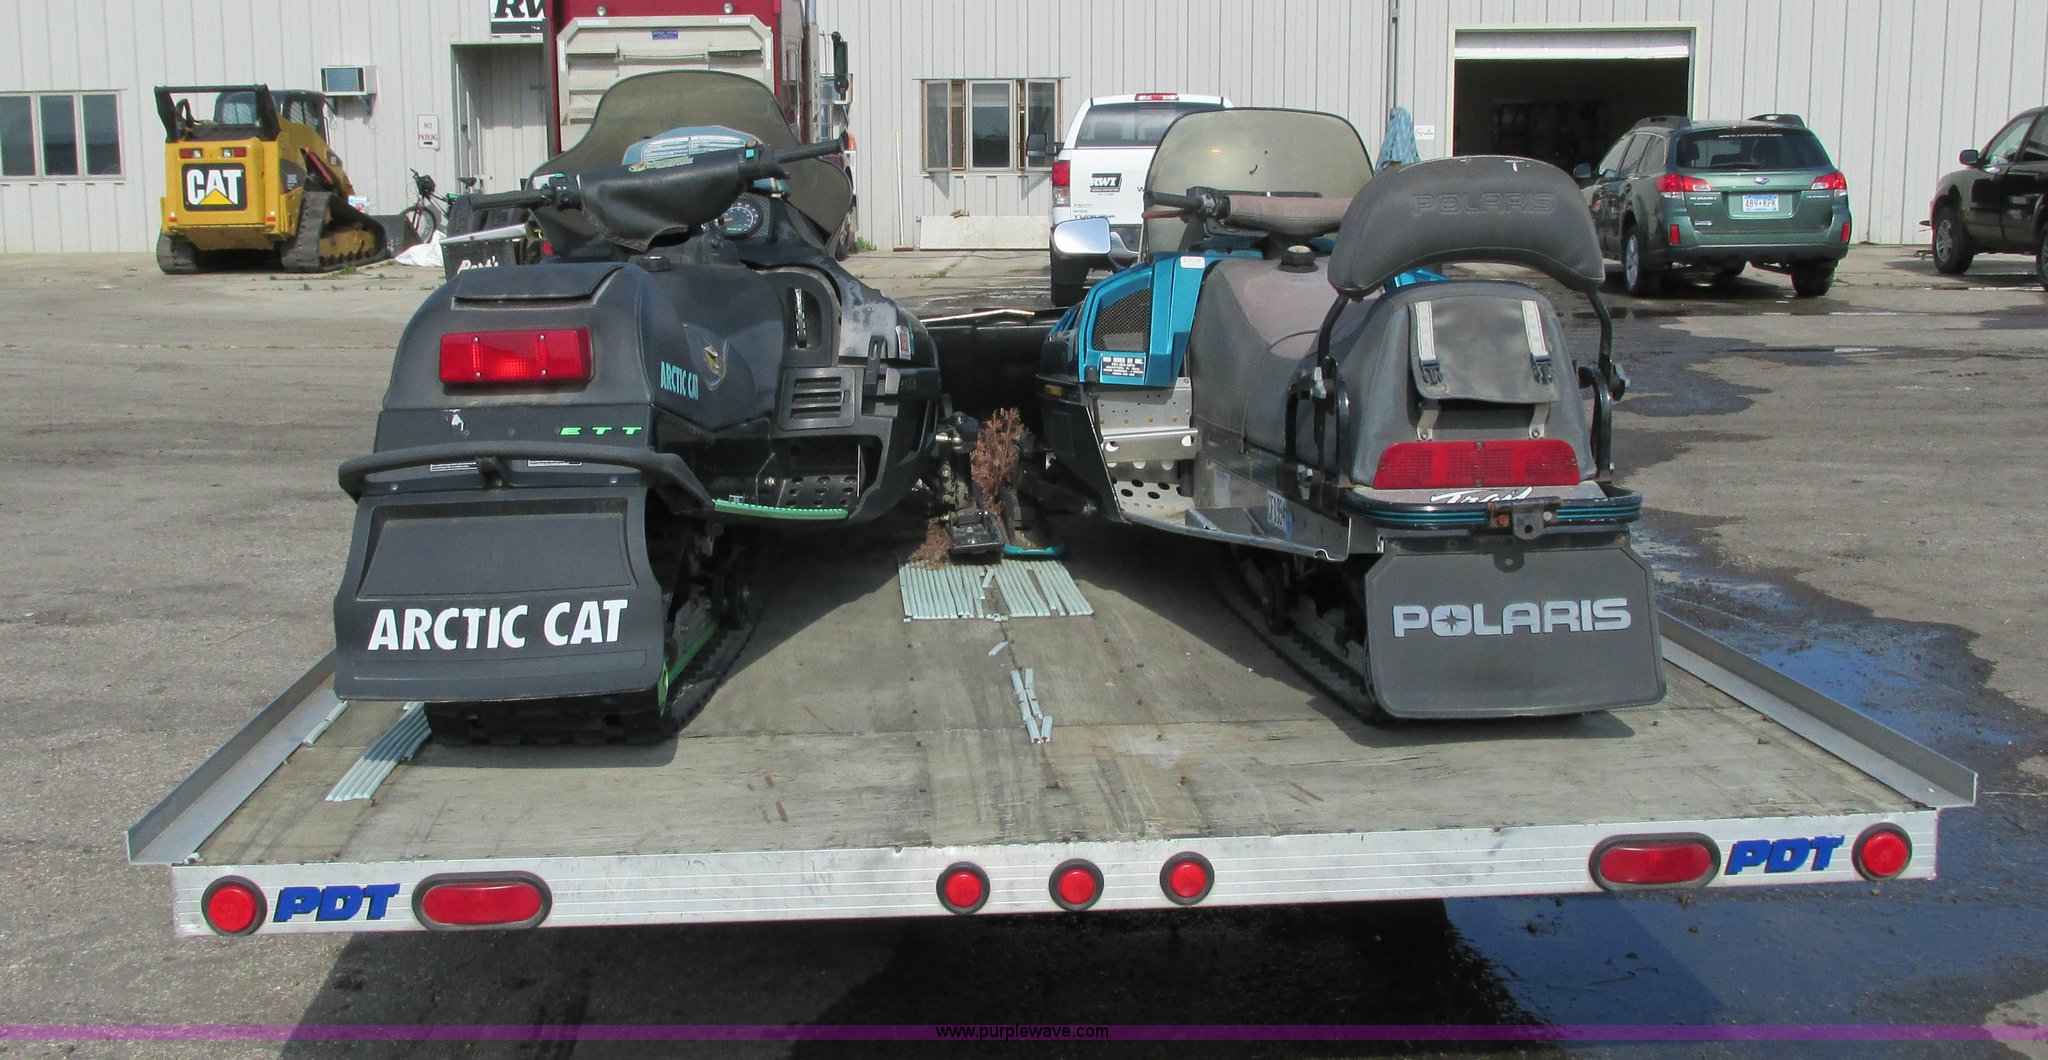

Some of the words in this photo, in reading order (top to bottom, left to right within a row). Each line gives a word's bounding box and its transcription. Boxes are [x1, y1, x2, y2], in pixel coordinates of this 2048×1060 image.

[187, 169, 243, 205] CAT
[1091, 177, 1117, 187] RWI
[1412, 193, 1554, 216] POLARIS
[661, 361, 686, 396] ARCTIC
[1430, 486, 1533, 504] Trail
[367, 605, 529, 651] ARCTIC
[543, 599, 629, 646] CAT
[1392, 598, 1632, 638] POLARIS
[1724, 835, 1845, 876] PDT
[273, 883, 401, 922] PDT
